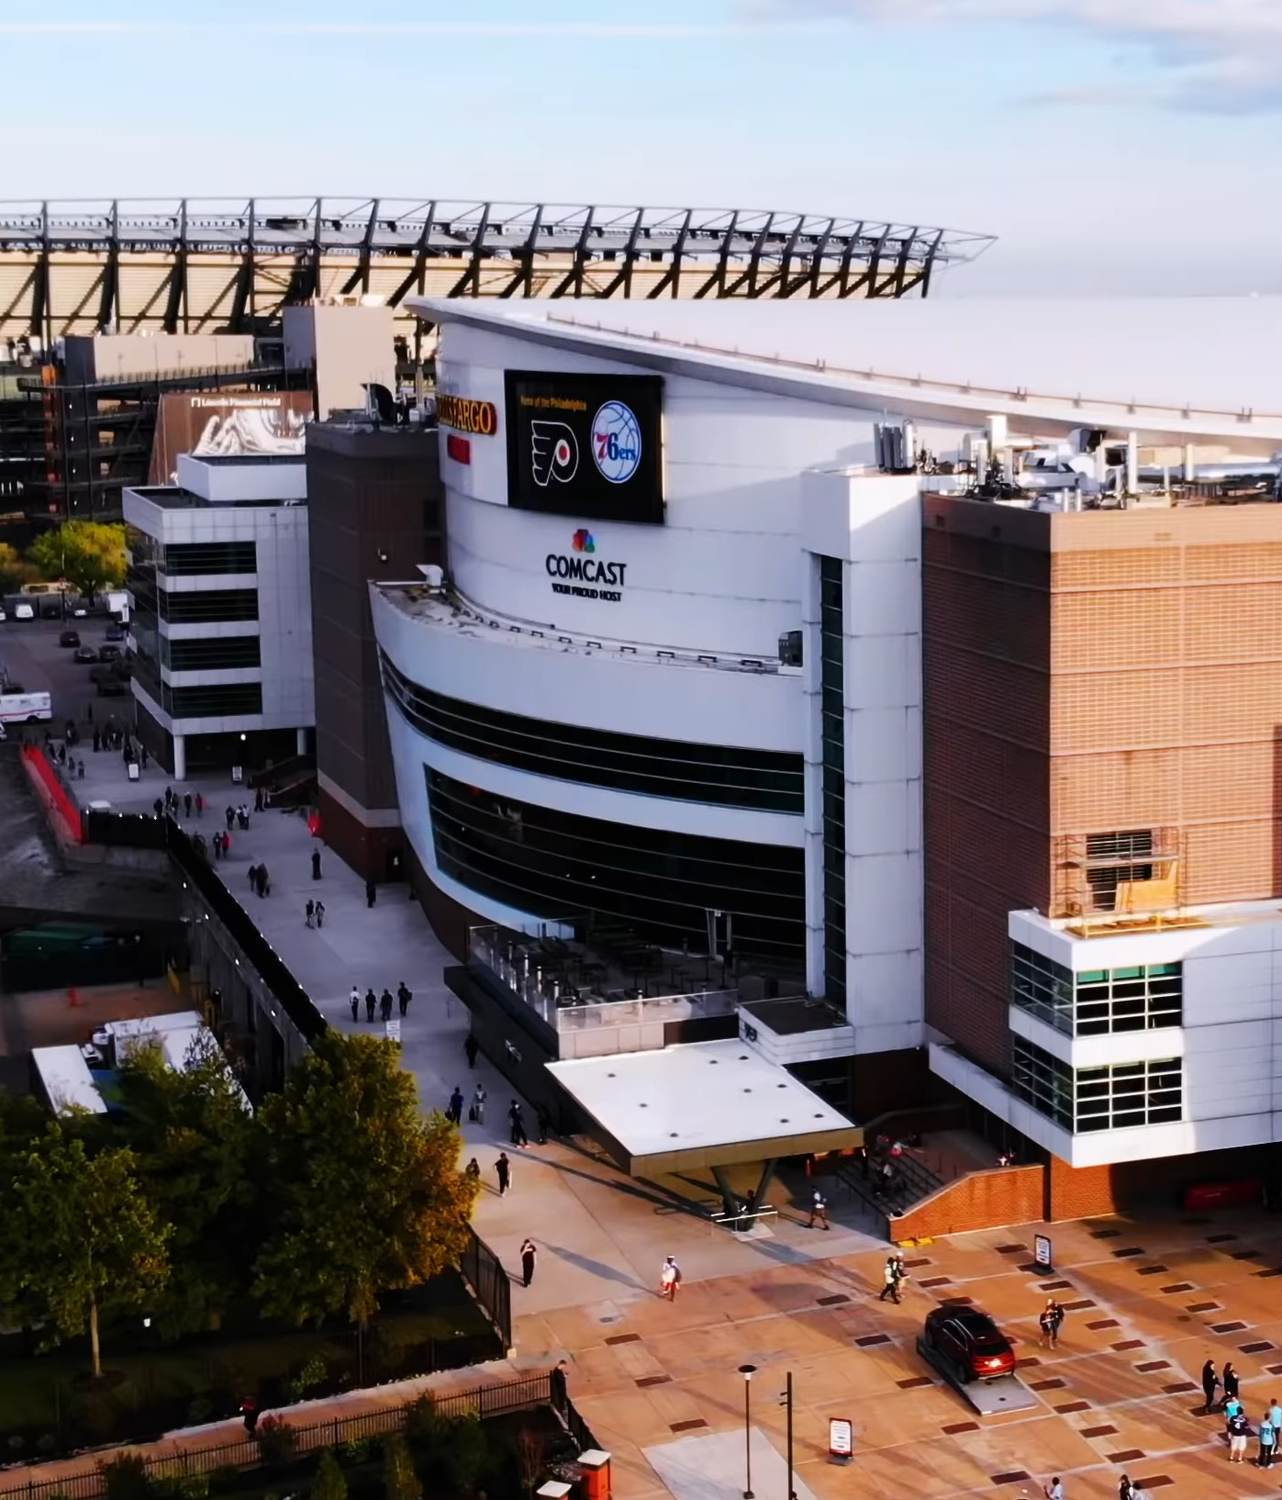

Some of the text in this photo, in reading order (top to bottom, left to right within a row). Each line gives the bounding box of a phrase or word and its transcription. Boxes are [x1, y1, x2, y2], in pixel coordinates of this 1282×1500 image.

[453, 399, 492, 433] FARGO
[594, 432, 637, 461] 76ers
[545, 553, 627, 587] COMCAST
[551, 582, 622, 602] YOUR PROUD HOST
